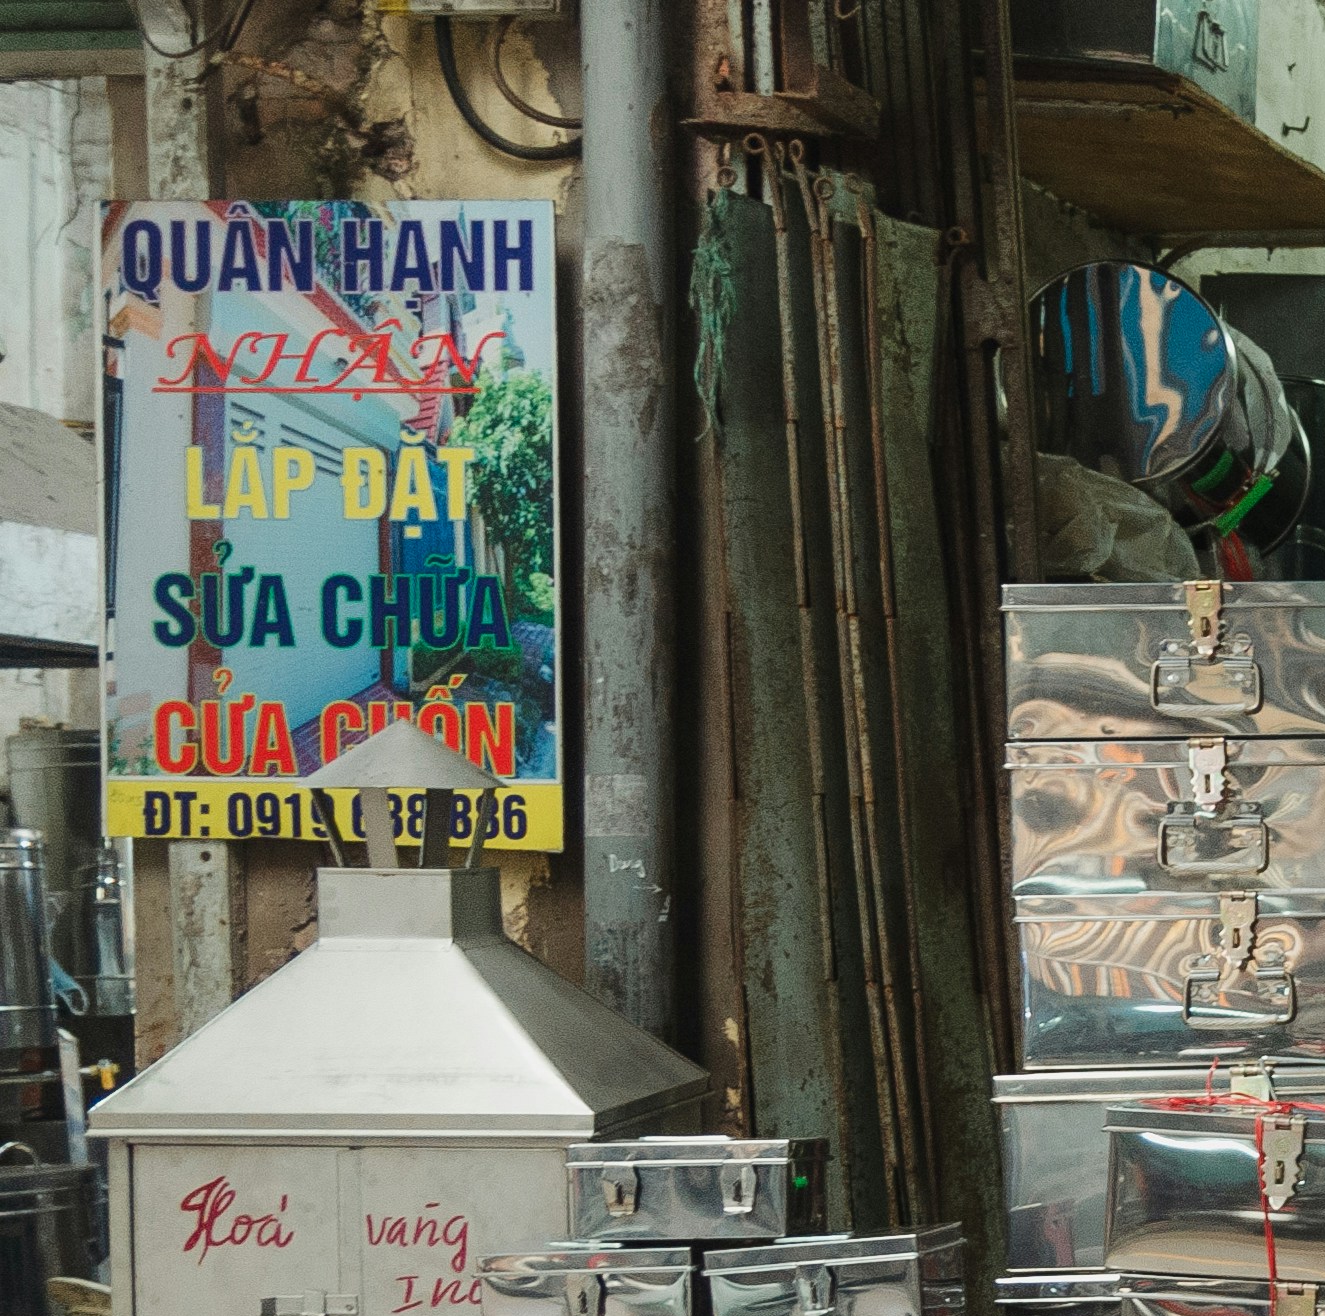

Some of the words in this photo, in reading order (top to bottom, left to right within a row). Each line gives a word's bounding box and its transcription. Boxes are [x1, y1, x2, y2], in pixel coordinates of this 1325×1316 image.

[121, 203, 315, 301] QUÂN
[343, 219, 534, 312] HẠNH
[157, 317, 507, 401] NHẬN
[184, 428, 316, 521] LẮP
[340, 432, 476, 539] ĐẶT
[153, 540, 295, 650] SỬA
[320, 553, 515, 651] CHỮA
[153, 668, 298, 777] CỬA
[143, 790, 211, 837] ĐT:
